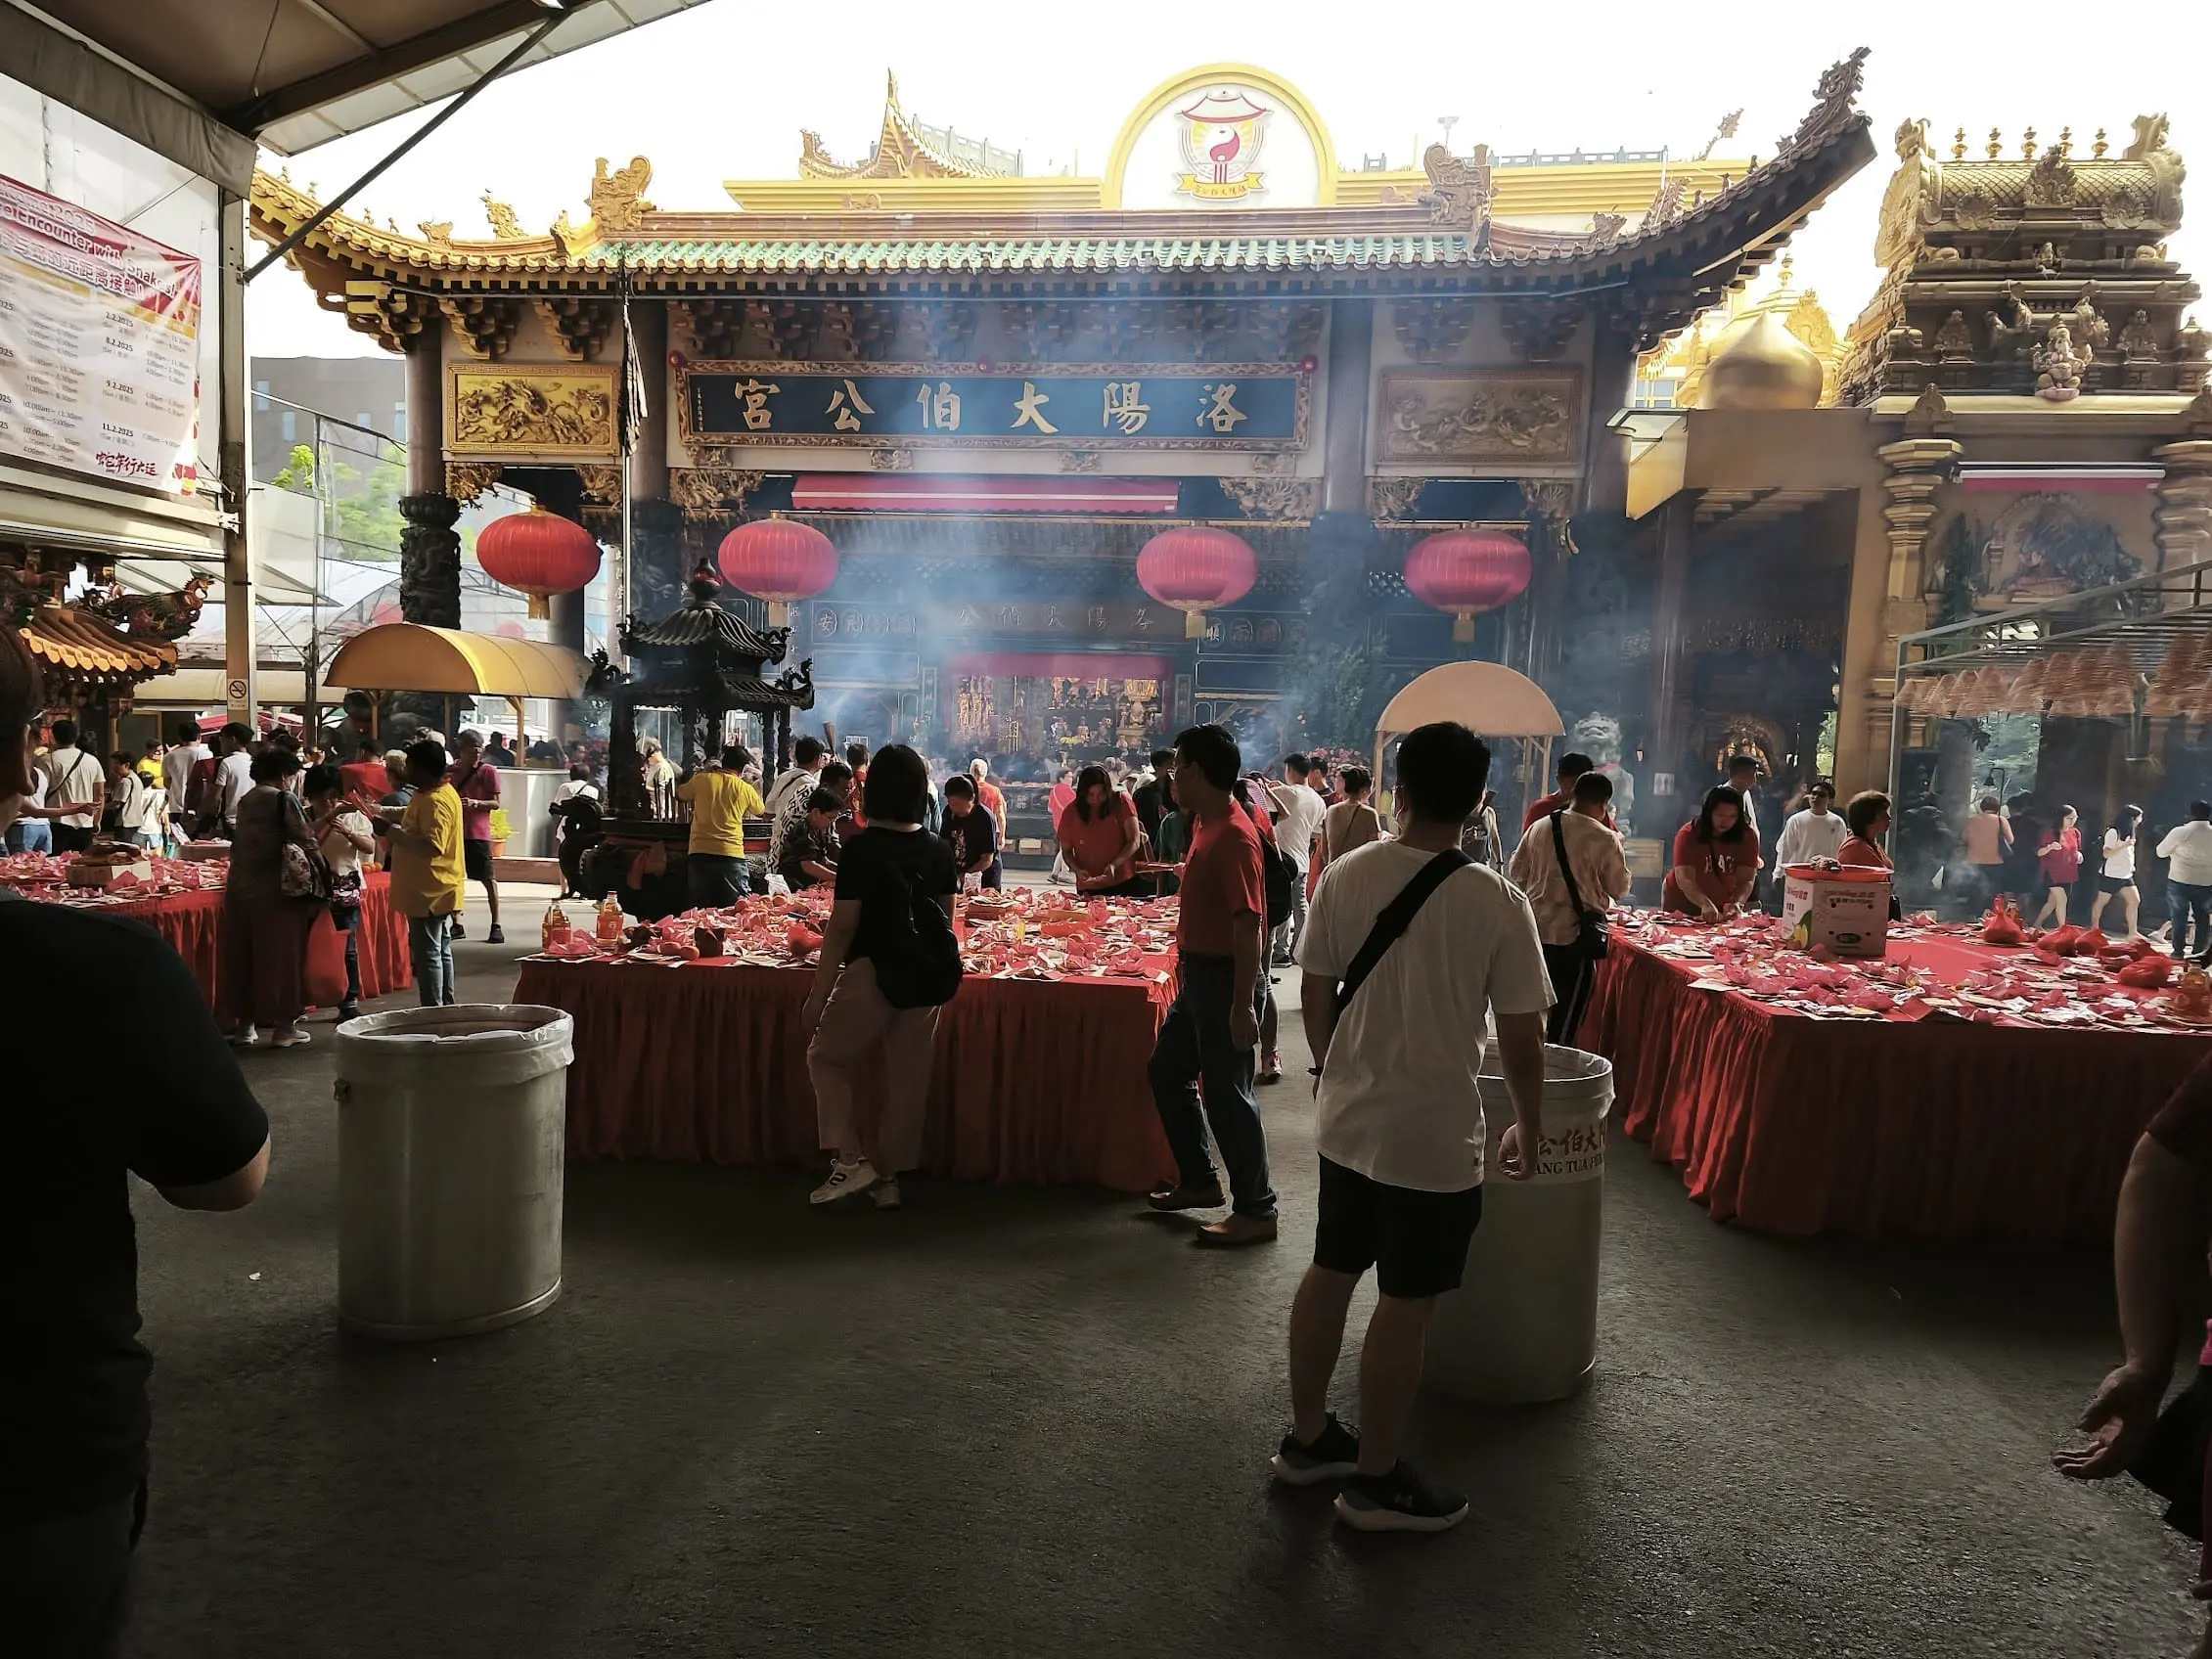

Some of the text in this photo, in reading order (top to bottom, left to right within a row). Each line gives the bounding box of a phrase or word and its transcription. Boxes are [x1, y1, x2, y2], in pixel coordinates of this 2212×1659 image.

[18, 207, 92, 252] Encounter
[94, 243, 124, 271] with
[102, 422, 134, 437] 11.2.2025
[96, 451, 158, 476] 蛇年行大运
